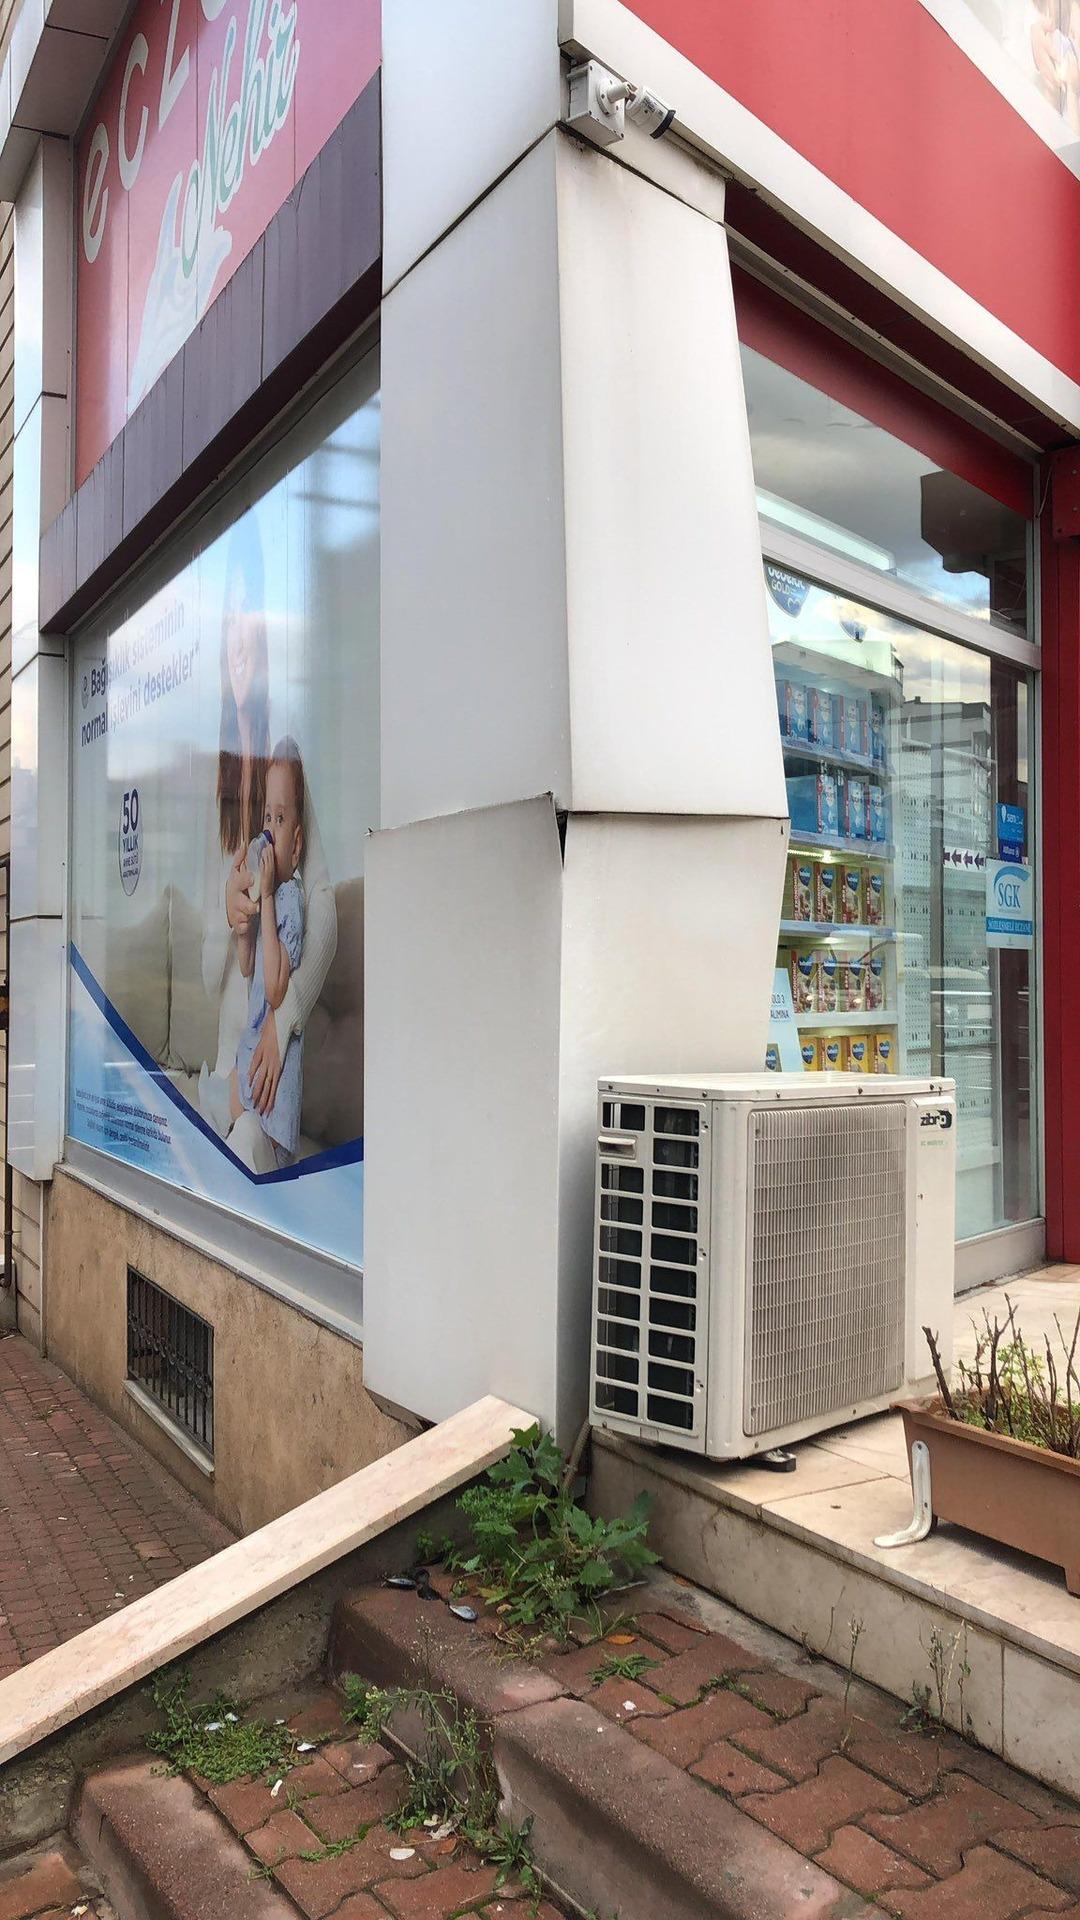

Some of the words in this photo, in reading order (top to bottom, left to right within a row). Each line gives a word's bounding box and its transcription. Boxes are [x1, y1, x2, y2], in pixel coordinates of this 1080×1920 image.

[83, 0, 226, 263] ecz
[132, 600, 185, 667] sisteminin
[81, 701, 108, 747] normal
[122, 788, 139, 834] 50
[998, 882, 1021, 909] SGK
